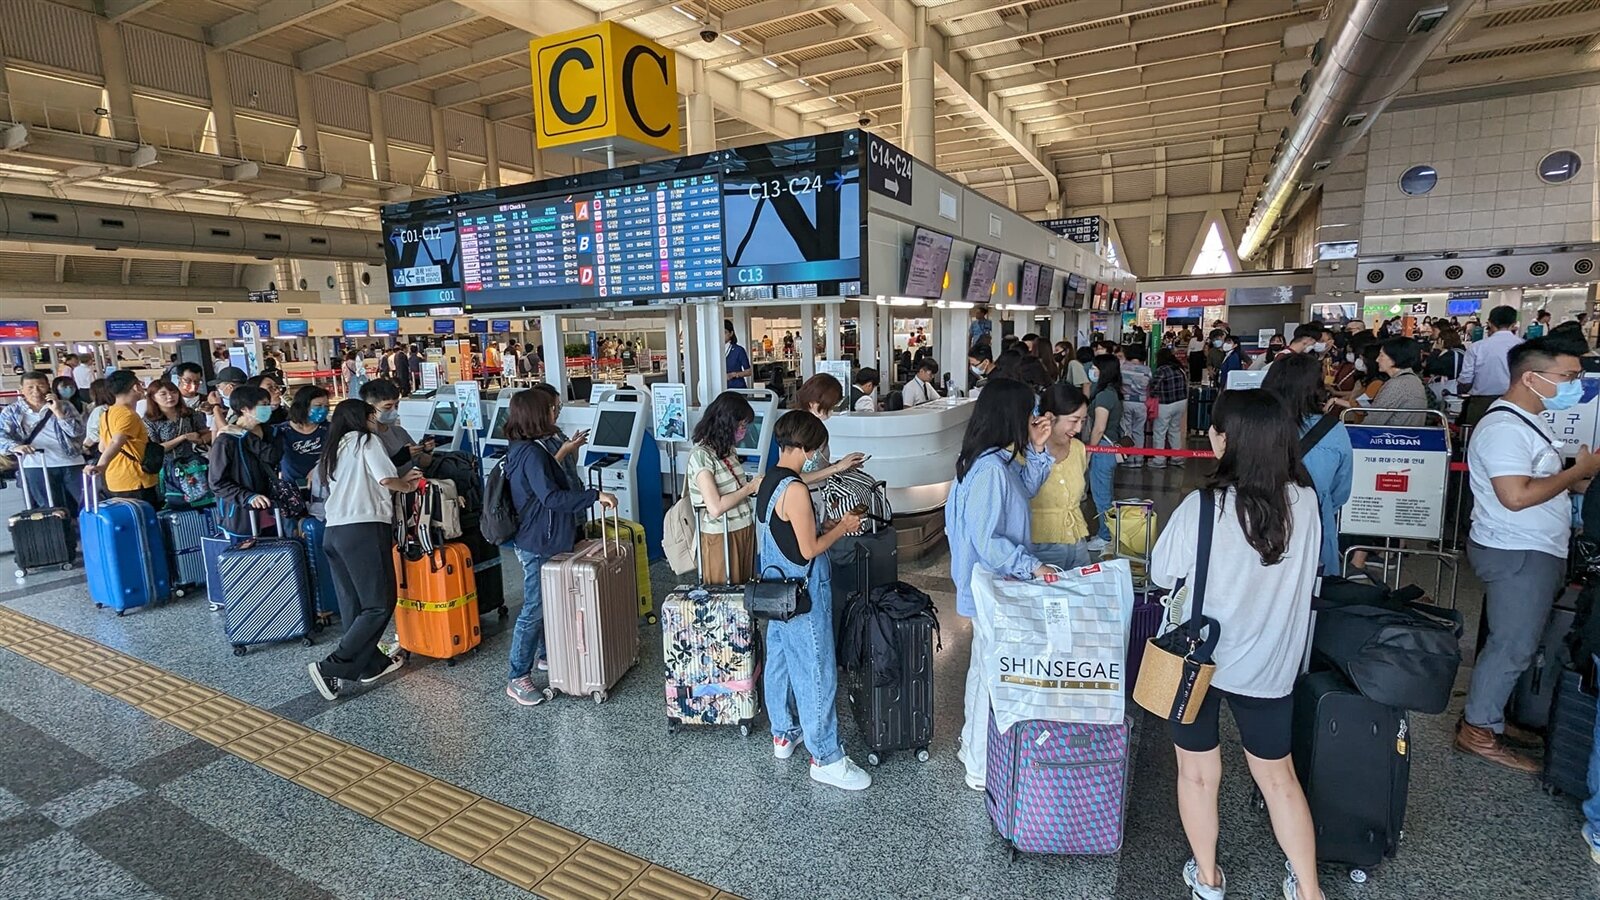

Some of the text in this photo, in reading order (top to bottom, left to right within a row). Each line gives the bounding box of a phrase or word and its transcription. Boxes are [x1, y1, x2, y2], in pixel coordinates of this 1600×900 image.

[549, 47, 598, 126] C
[622, 45, 672, 138] C
[749, 175, 823, 200] C13-C24
[580, 203, 589, 216] A
[400, 227, 442, 244] C01-C12
[580, 236, 590, 251] B
[581, 270, 593, 282] D
[740, 268, 764, 283] C13
[440, 290, 455, 301] C01
[1000, 657, 1119, 680] SHINSEGAE
